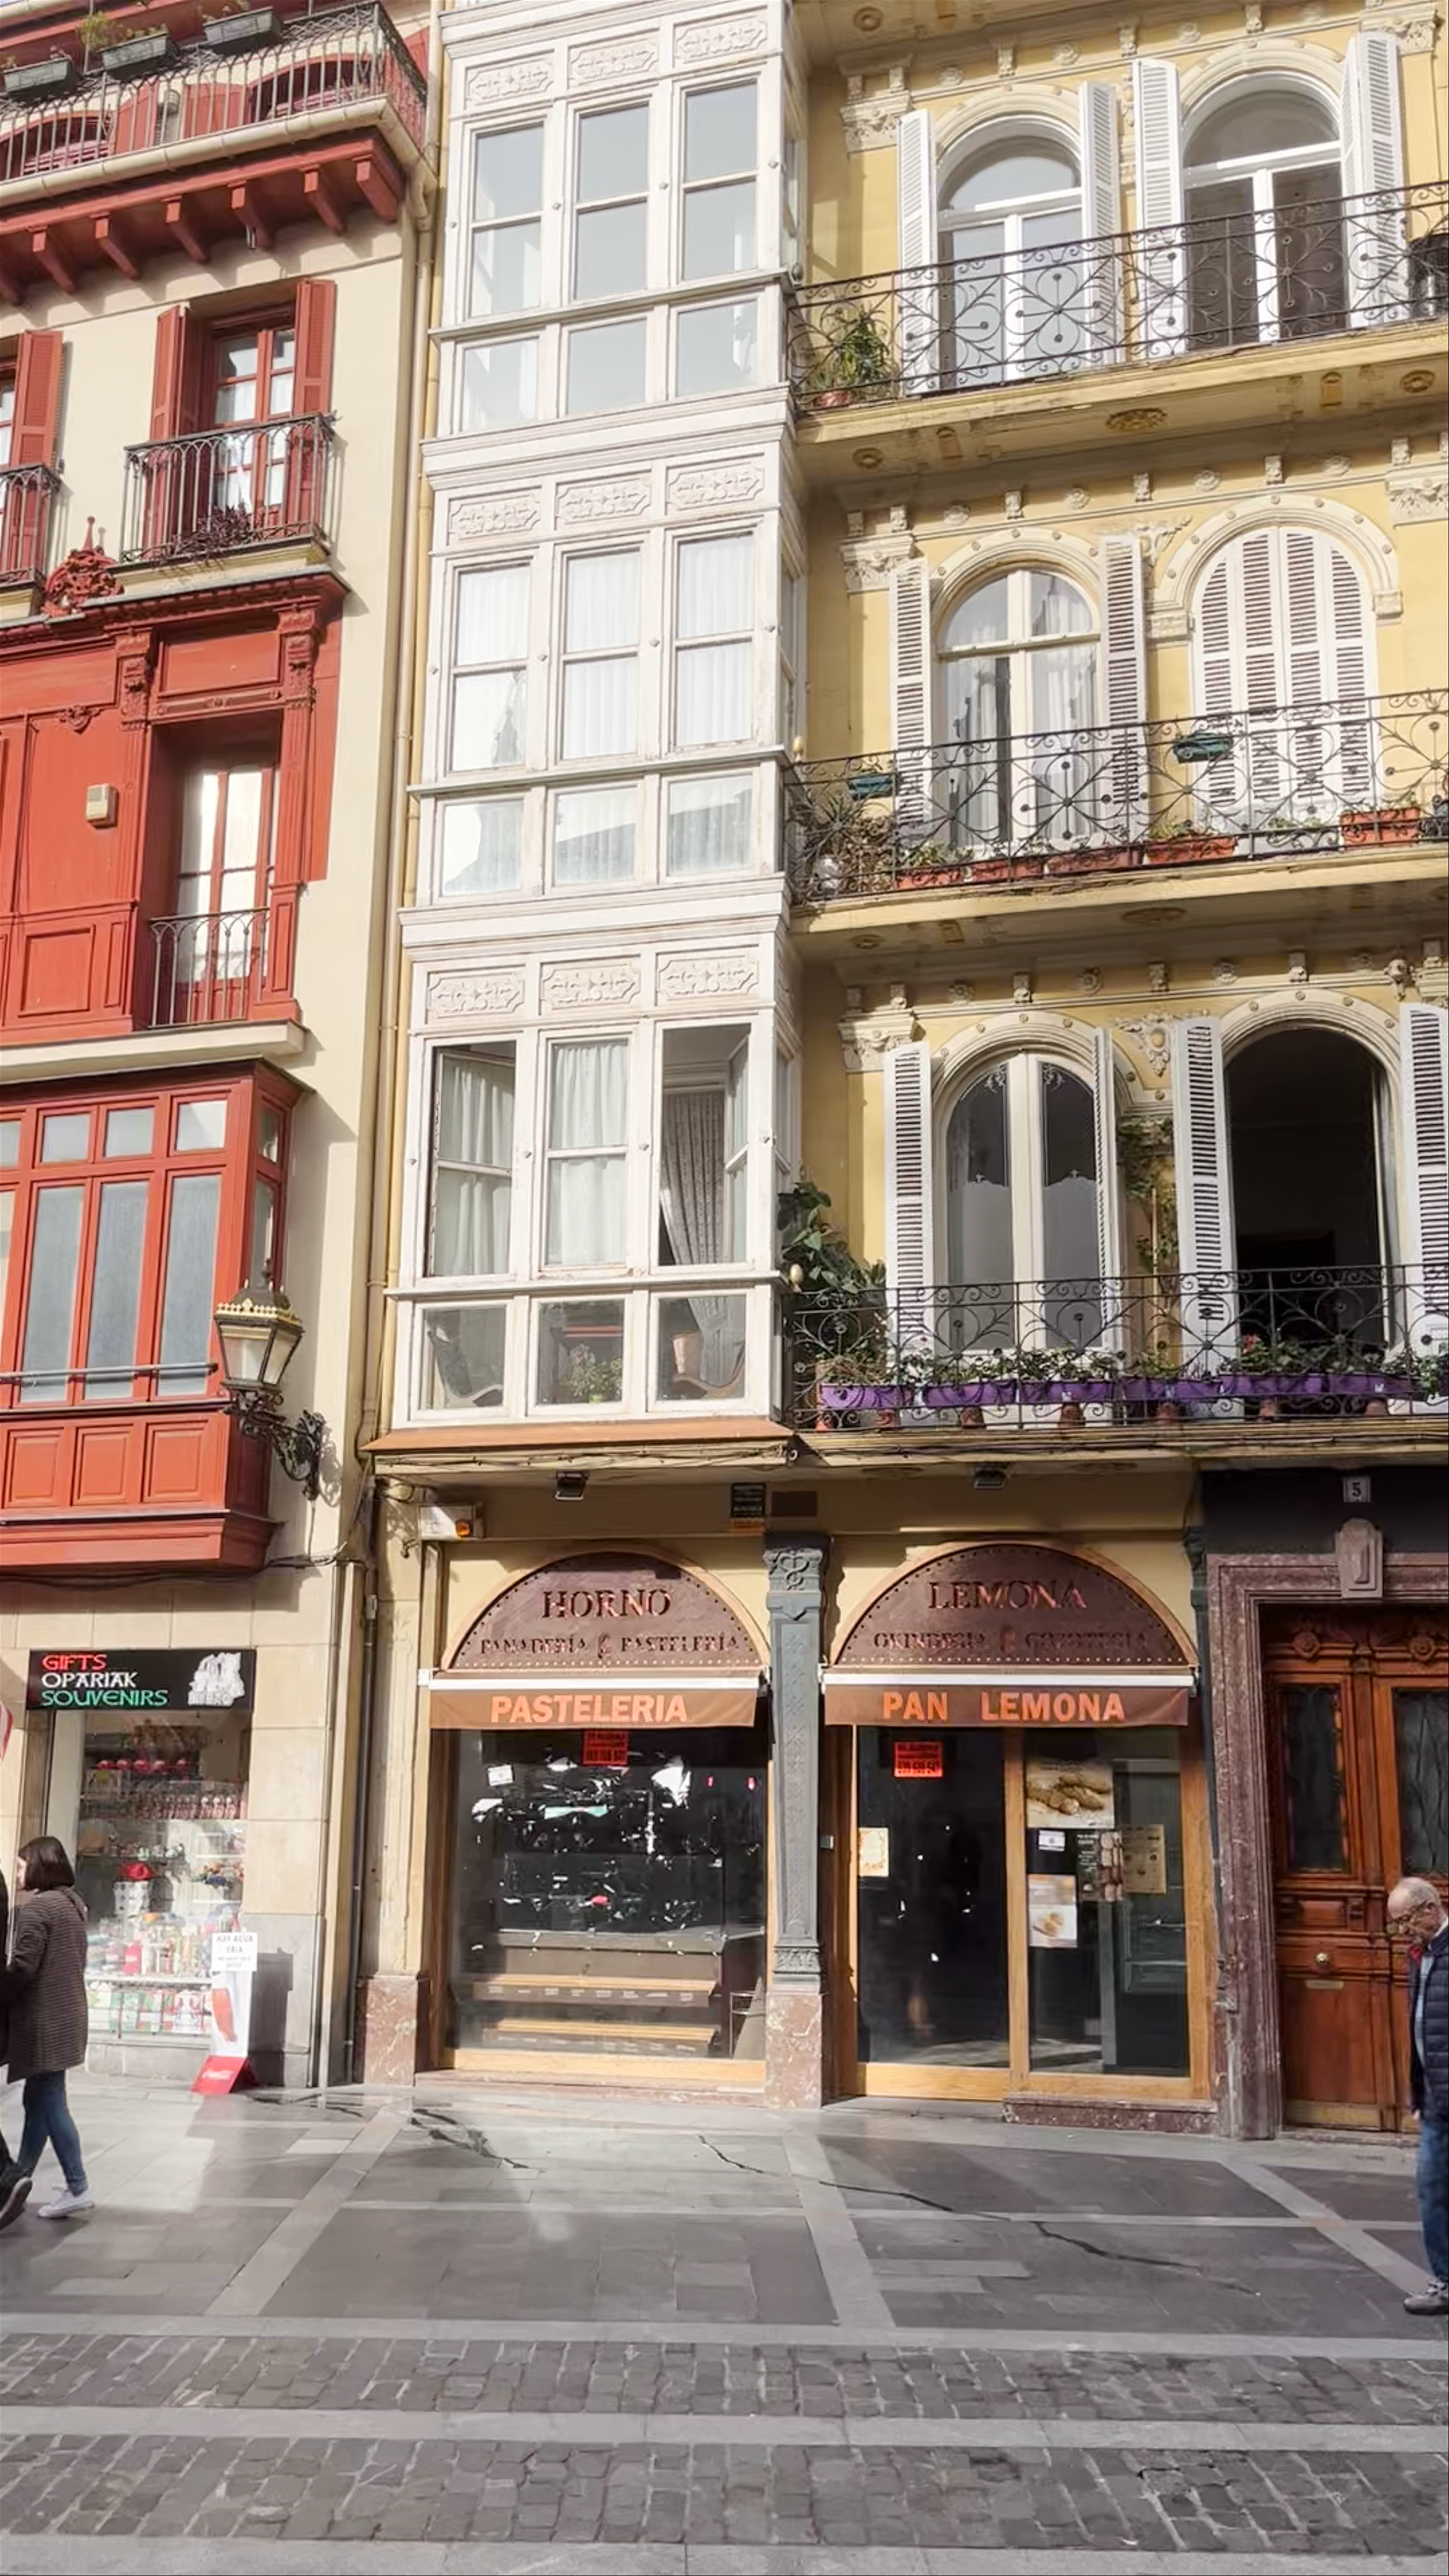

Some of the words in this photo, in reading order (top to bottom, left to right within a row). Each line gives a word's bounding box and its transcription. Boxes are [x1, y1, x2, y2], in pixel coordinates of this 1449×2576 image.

[1352, 1481, 1361, 1496] 5
[541, 1589, 671, 1618] HORNO
[928, 1581, 1087, 1609] LEMONA
[42, 1655, 107, 1670] GIFTS
[42, 1672, 137, 1688] OPARIAK
[42, 1690, 168, 1706] SOUVENIRS
[491, 1695, 687, 1723] PASTELERIA
[883, 1692, 948, 1720] PAN
[981, 1692, 1125, 1721] LEMONA
